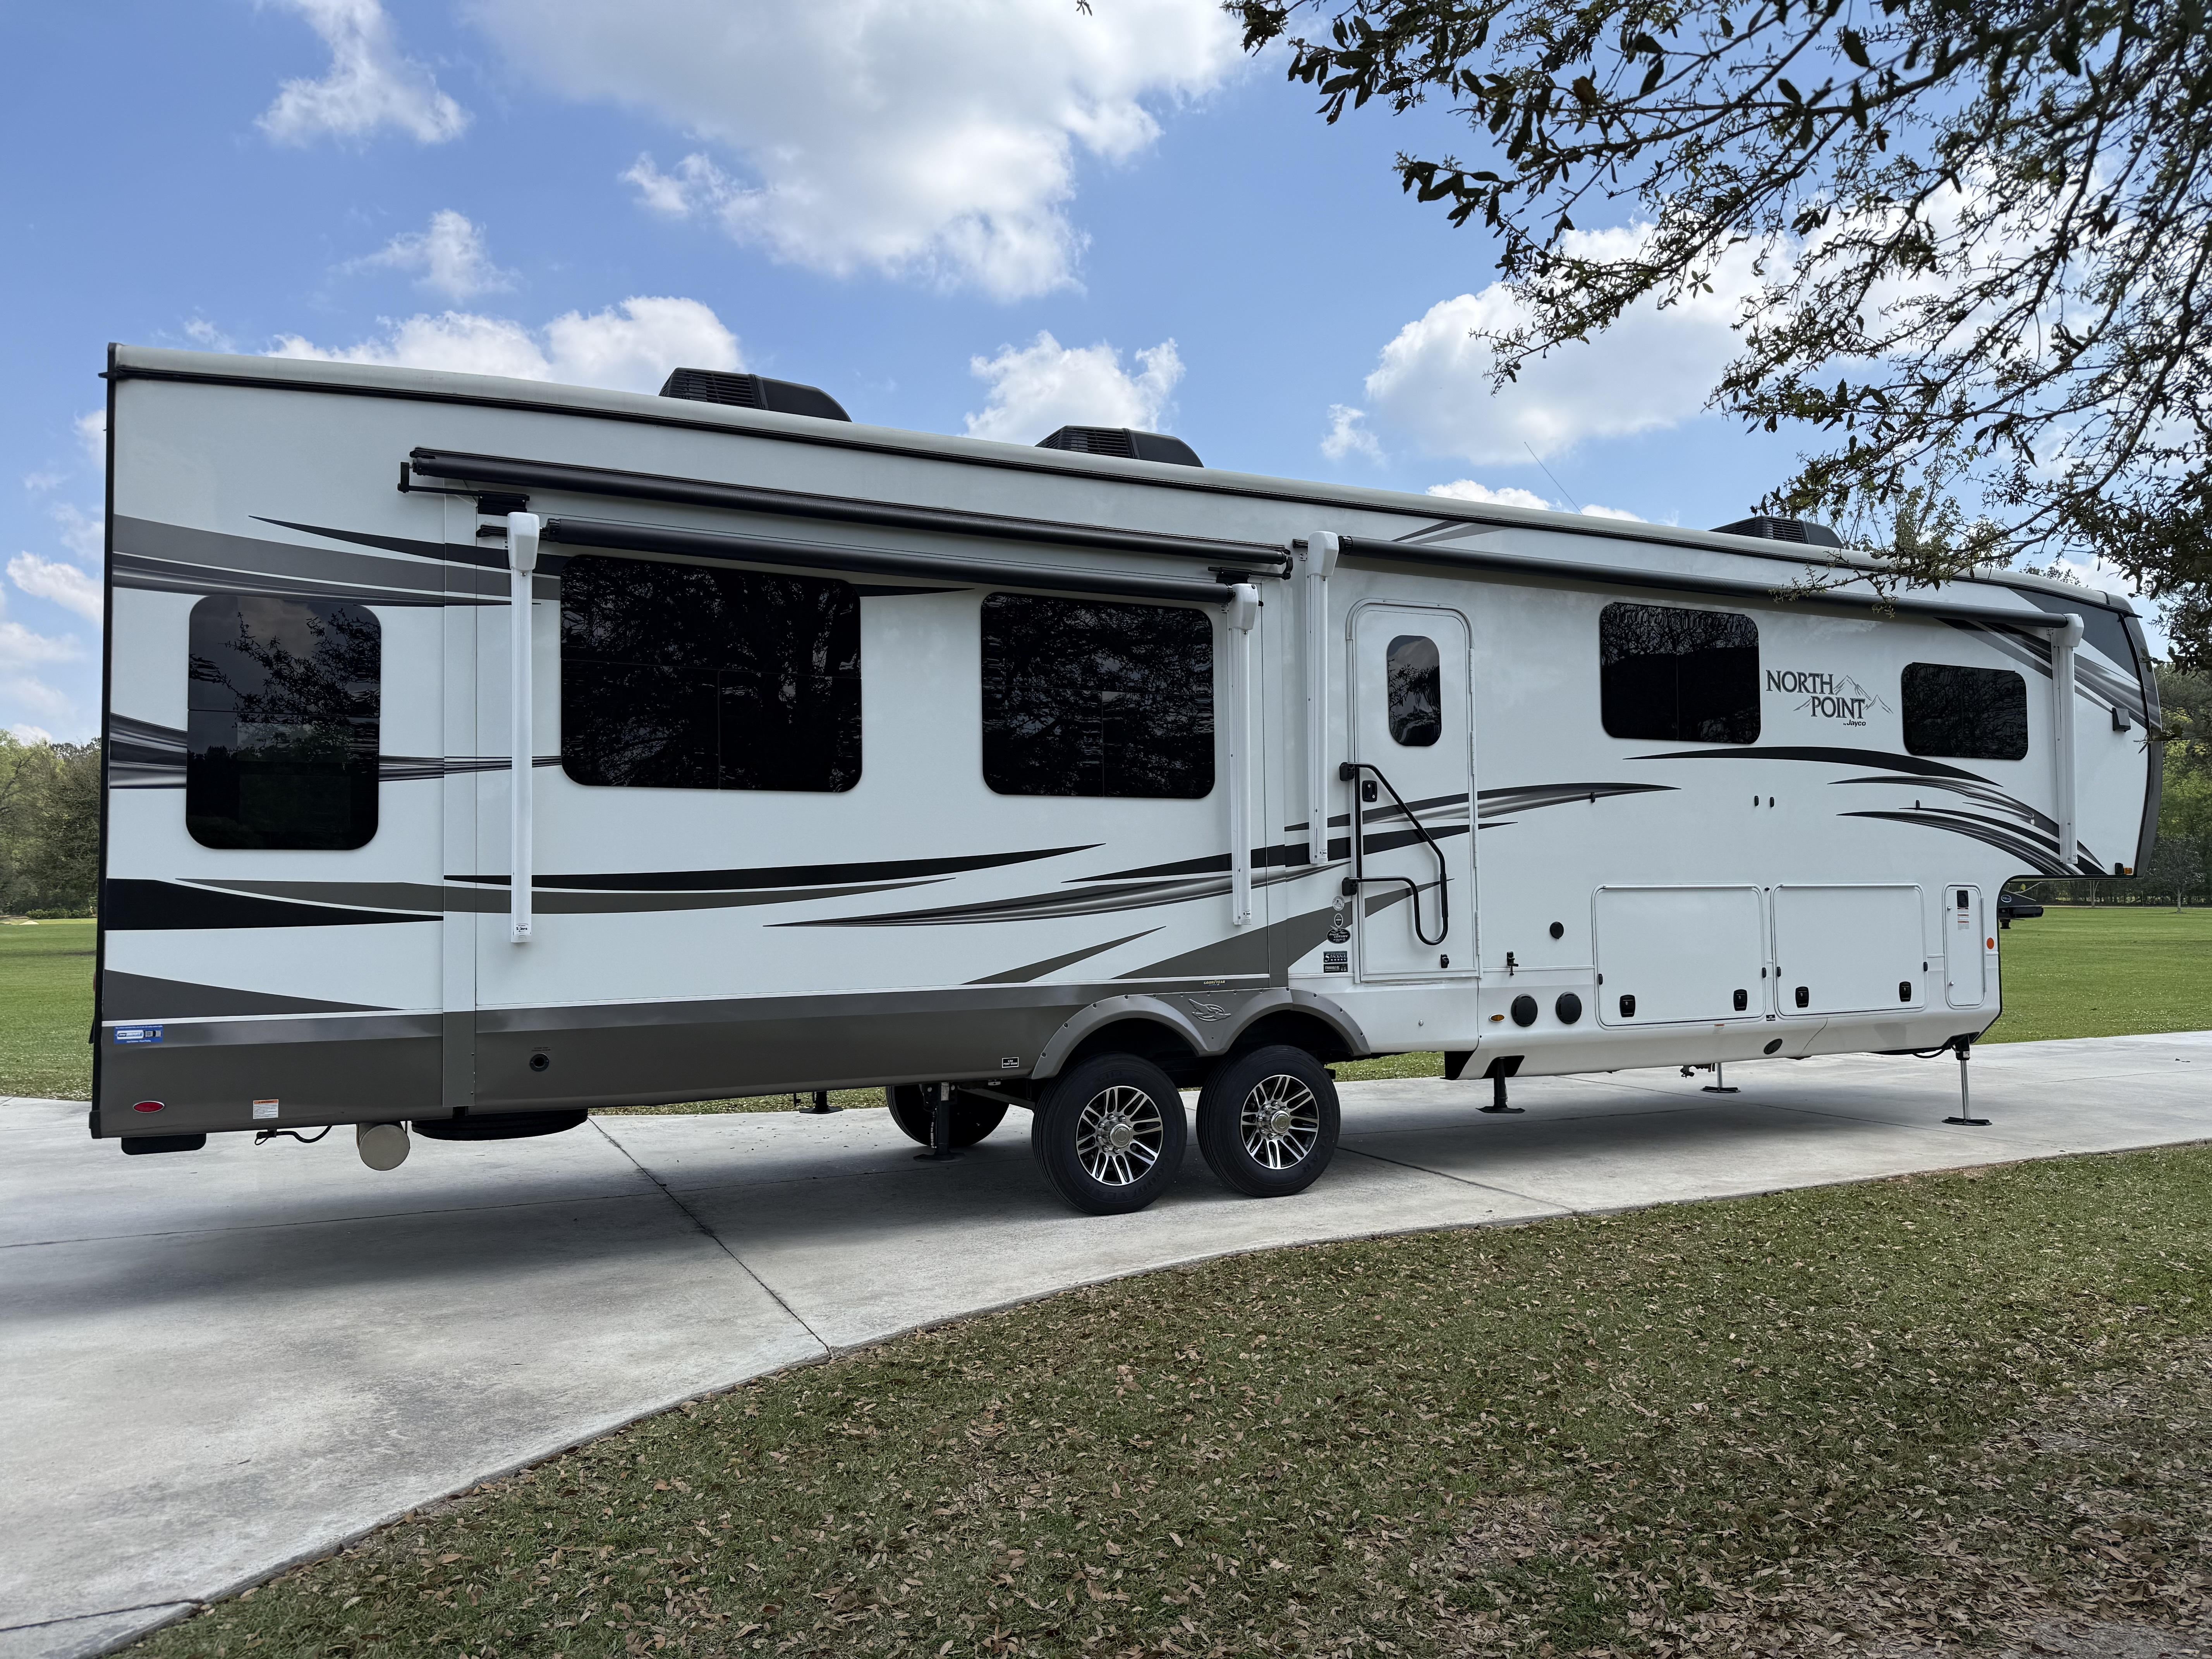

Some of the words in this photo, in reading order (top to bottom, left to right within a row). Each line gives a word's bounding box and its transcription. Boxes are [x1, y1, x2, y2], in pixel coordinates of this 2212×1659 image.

[1765, 670, 1834, 695] NORTH
[1810, 696, 1866, 719] POINT
[1324, 953, 1330, 962] 5
[1085, 1158, 1170, 1200] GOODYEAR
